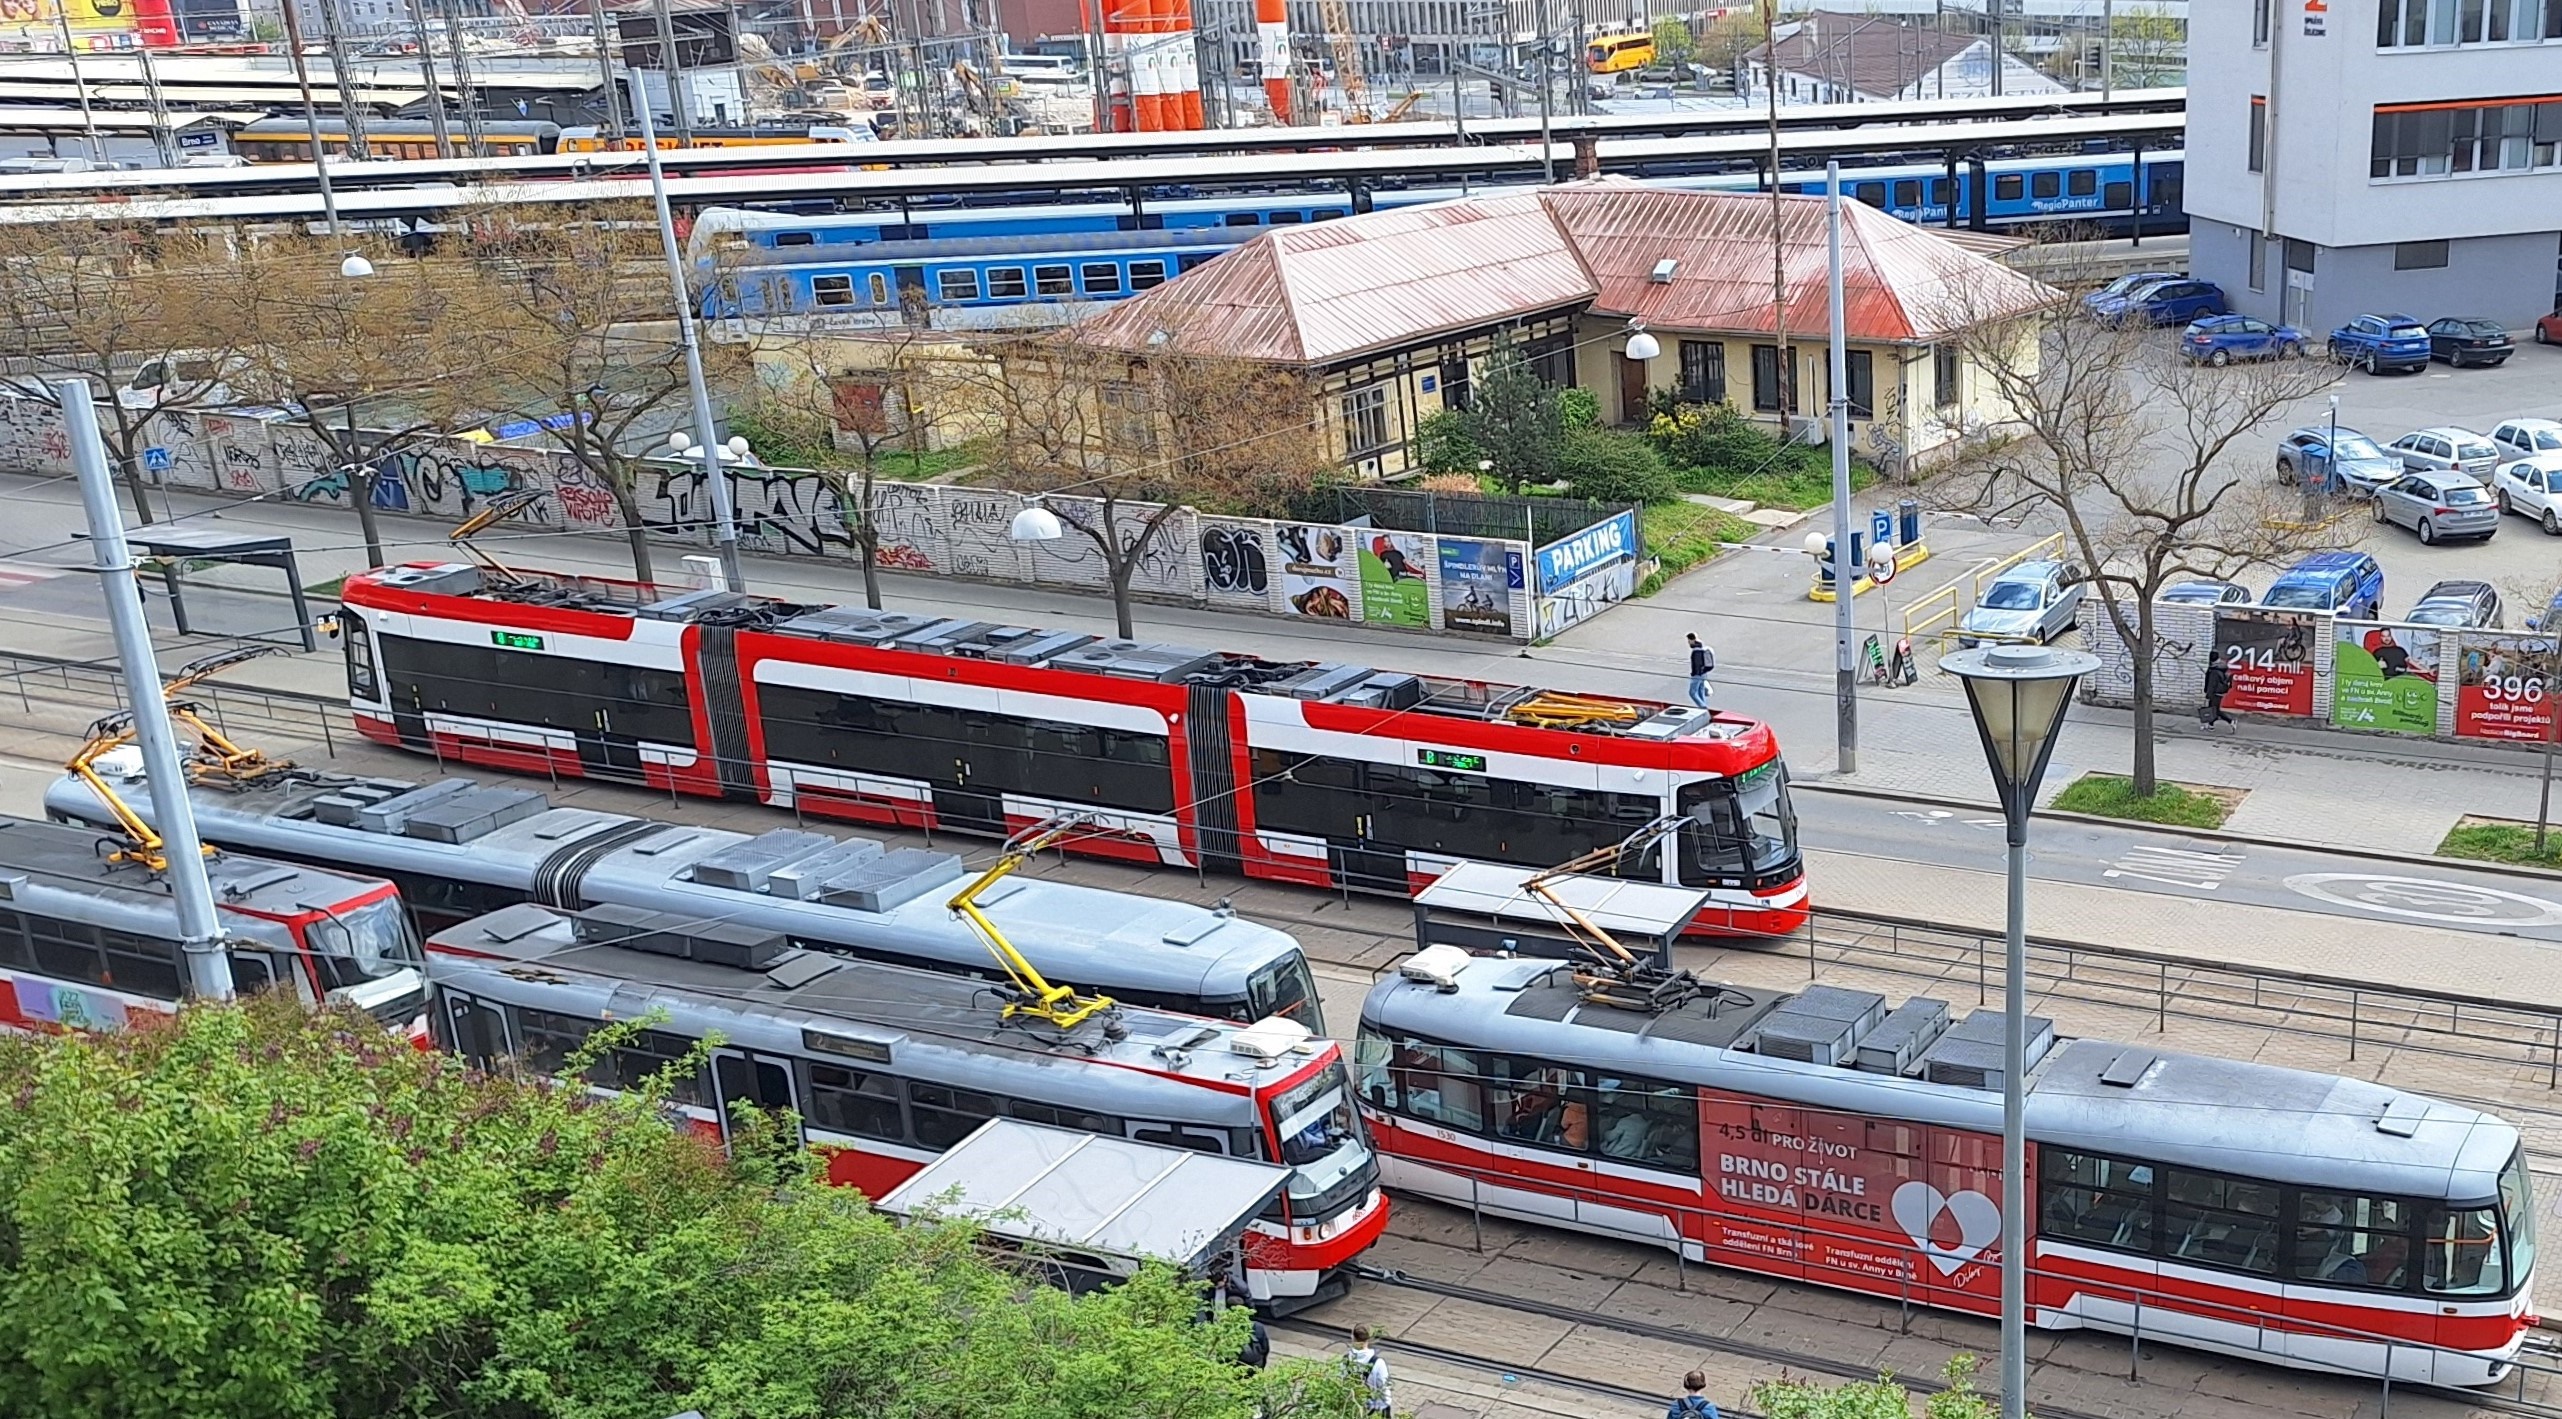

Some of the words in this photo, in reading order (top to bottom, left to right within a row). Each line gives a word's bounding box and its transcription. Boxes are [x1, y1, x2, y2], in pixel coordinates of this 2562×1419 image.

[2038, 197, 2099, 211] RegioPanter
[1876, 520, 1888, 540] P
[1551, 522, 1622, 575] PARKING
[2226, 645, 2275, 672] 214
[2277, 661, 2304, 675] mil.
[2482, 674, 2543, 703] 396
[1719, 1122, 1746, 1141] 4,5
[1772, 1133, 1805, 1150] PRO
[1720, 1153, 1788, 1182] BRNO
[1794, 1167, 1866, 1196] STÁLE
[1721, 1177, 1798, 1208] HLEDÁ
[1804, 1191, 1881, 1222] DÁRCE
[1721, 1226, 1769, 1243] Transfuzní
[1722, 1237, 1760, 1252] oddělení
[1761, 1243, 1775, 1254] FN
[1825, 1245, 1873, 1263] Transfuzní
[1826, 1256, 1838, 1266] FN
[1839, 1259, 1846, 1267] u
[1862, 1263, 1886, 1276] Anny
